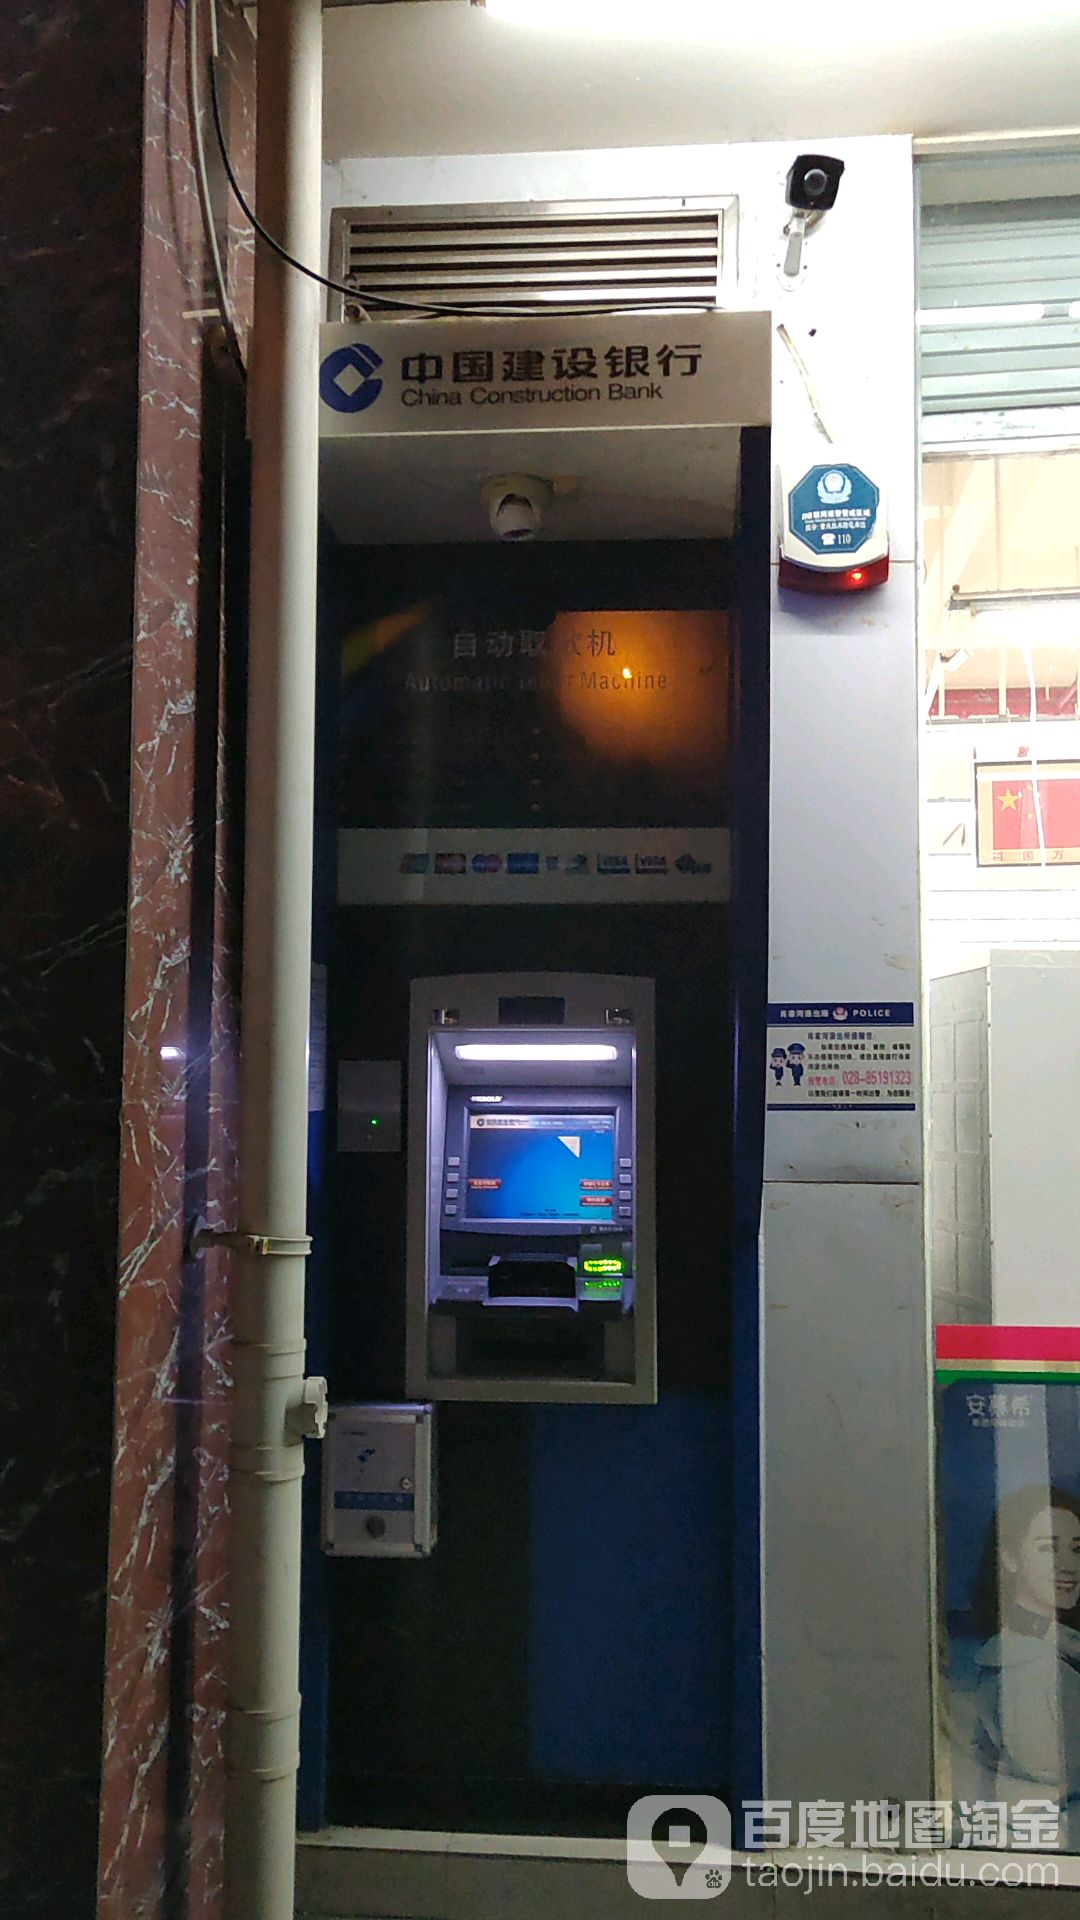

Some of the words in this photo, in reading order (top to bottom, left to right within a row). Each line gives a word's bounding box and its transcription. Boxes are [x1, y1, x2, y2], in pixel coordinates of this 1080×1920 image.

[402, 344, 702, 384] 中国建设银行
[401, 388, 461, 406] China
[471, 384, 600, 404] Construction
[608, 382, 663, 400] Bank
[838, 533, 851, 545] 110
[580, 671, 667, 690] Machine
[853, 1009, 891, 1018] POLICE
[842, 1071, 912, 1085] 028-85191323
